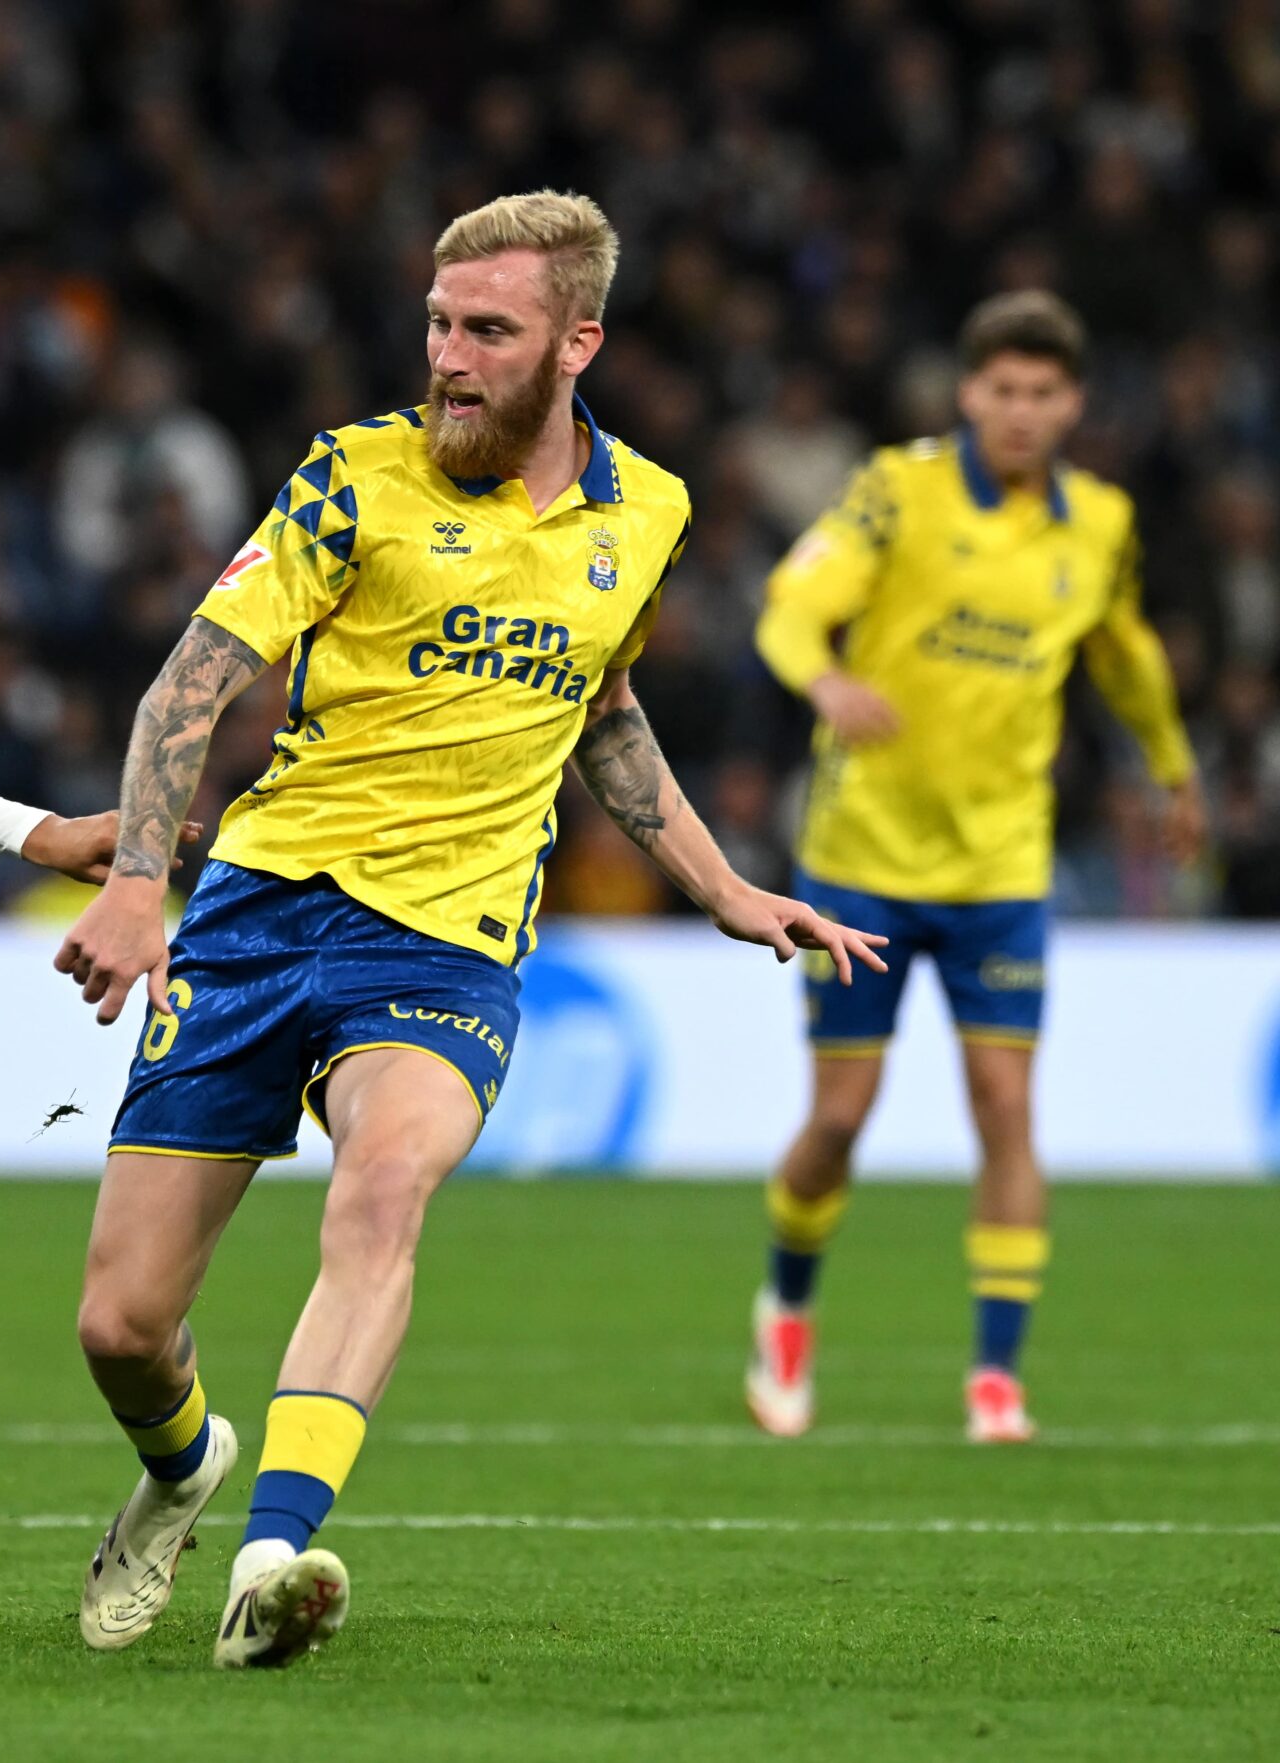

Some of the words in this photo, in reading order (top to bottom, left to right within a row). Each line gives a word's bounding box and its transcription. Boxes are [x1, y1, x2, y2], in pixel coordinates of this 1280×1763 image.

[430, 544, 472, 555] hummel
[442, 604, 570, 656] Gran
[408, 642, 588, 704] Canaria
